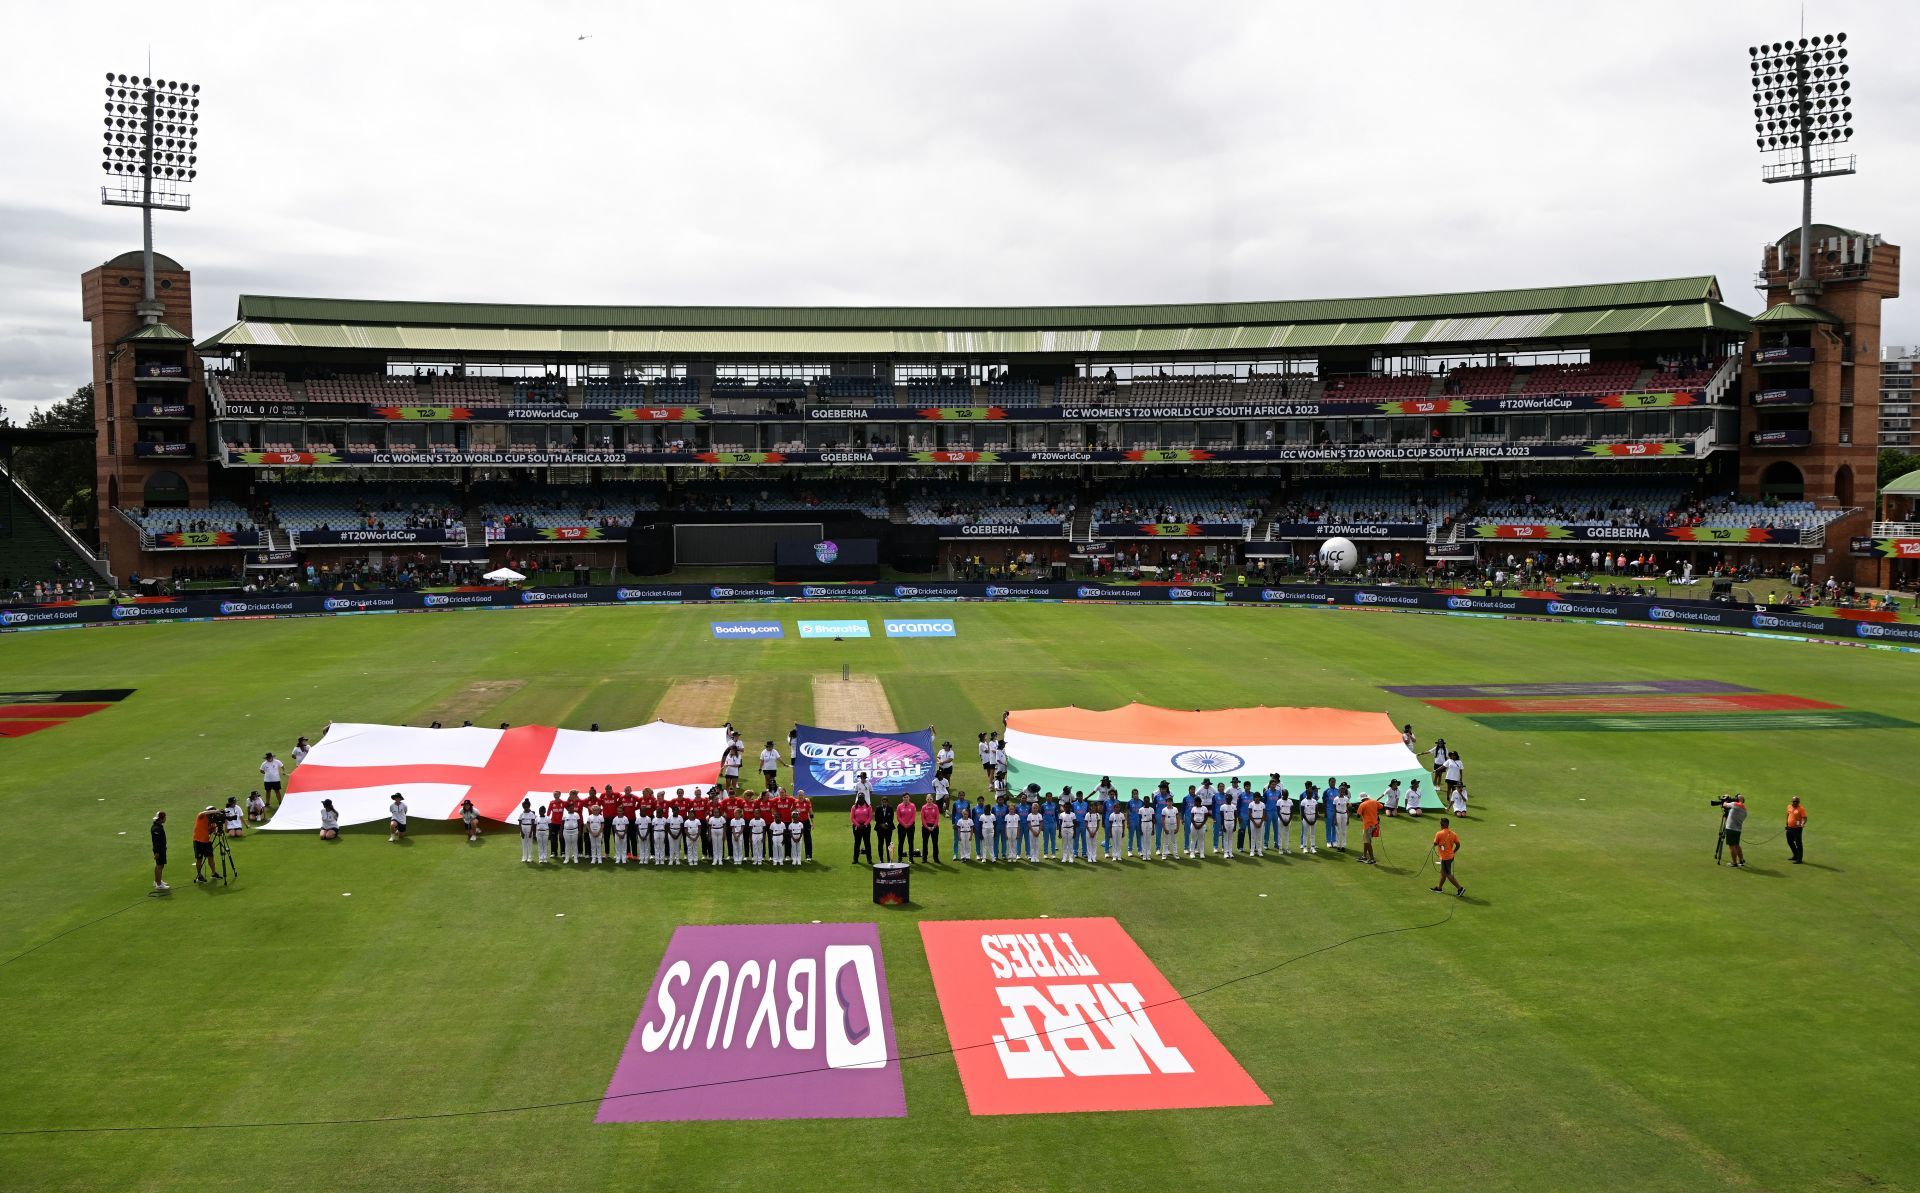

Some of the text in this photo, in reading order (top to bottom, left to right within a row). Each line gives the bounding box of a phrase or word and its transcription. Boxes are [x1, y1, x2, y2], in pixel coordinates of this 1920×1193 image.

[1499, 399, 1572, 408] #T20WorldCup
[226, 406, 254, 414] TOTAL
[508, 410, 579, 419] #T20WorldCup
[811, 410, 868, 418] GQEBERHA
[1062, 406, 1319, 417] ICC WOMEN'S T20 WORLD CUP SOUTH AFRICA 2023
[820, 453, 873, 462] GQEBERHA
[1031, 452, 1091, 461] #T20WorldCup
[1298, 450, 1346, 458] WOMEN'S
[1348, 450, 1365, 458] T20
[1367, 449, 1404, 458] WORLD
[1406, 449, 1427, 457] CUP
[1429, 448, 1464, 457] SOUTH
[1466, 448, 1503, 456] AFRICA
[1506, 447, 1530, 456] 2023
[392, 454, 443, 462] WOMEN'S
[962, 526, 1020, 534] GQEBERHA
[1316, 526, 1388, 536] #T20WorldCup
[1587, 528, 1650, 538] GQEBERHA
[340, 531, 416, 541] #T20WorldCup
[1326, 550, 1344, 560] ICC
[1458, 599, 1470, 607] ICC
[1559, 604, 1571, 612] ICC
[1573, 605, 1595, 613] Cricket
[13, 613, 26, 622] ICC
[1661, 609, 1673, 618] ICC
[1676, 611, 1698, 619] Cricket
[887, 623, 952, 632] aramco
[1765, 617, 1776, 625] ICC
[1779, 619, 1802, 628] Cricket
[1807, 622, 1824, 630] Good
[716, 624, 780, 635] Booking.com
[815, 624, 867, 634] BharatPe
[1870, 626, 1882, 635] ICC
[1884, 628, 1908, 637] Cricket
[826, 747, 860, 757] ICC
[981, 933, 1099, 979] TYRES
[641, 958, 816, 1052] BYJU'S
[992, 983, 1195, 1079] MRF
